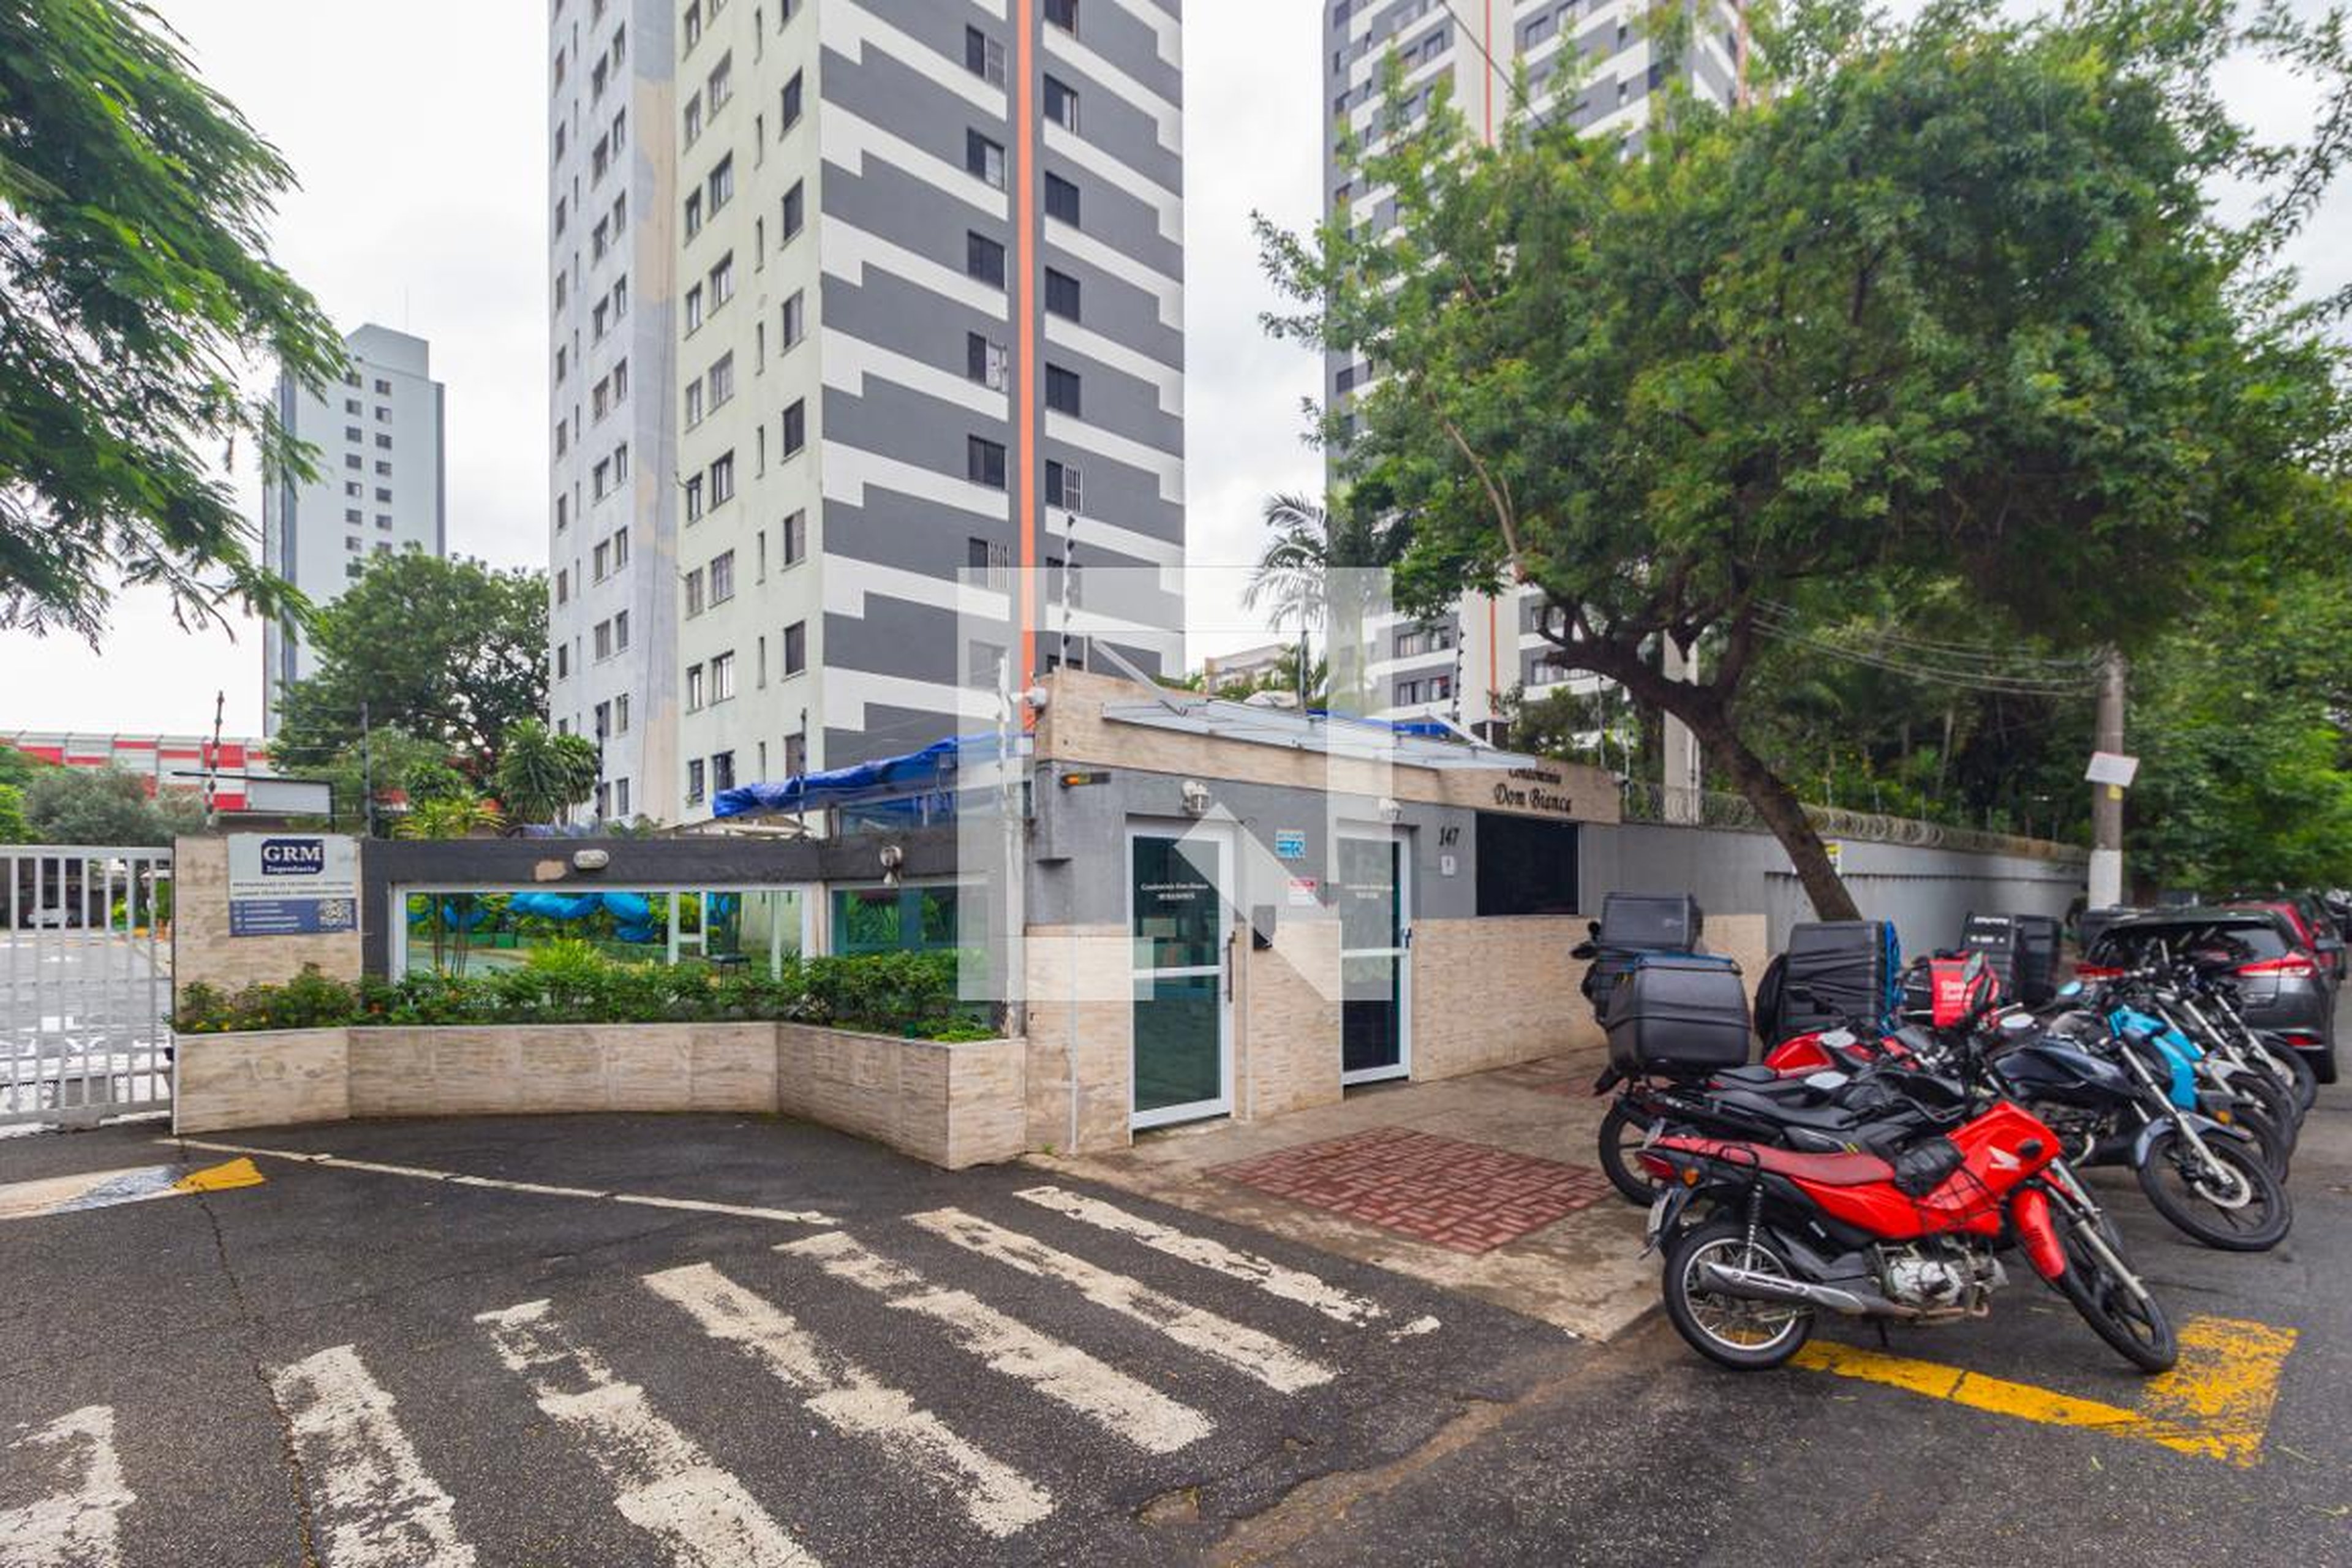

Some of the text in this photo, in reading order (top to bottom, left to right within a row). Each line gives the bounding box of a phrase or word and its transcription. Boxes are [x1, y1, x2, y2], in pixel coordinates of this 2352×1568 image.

[1494, 783, 1572, 813] Dom Bianca
[1439, 826, 1460, 846] 147
[263, 846, 321, 862] GRM
